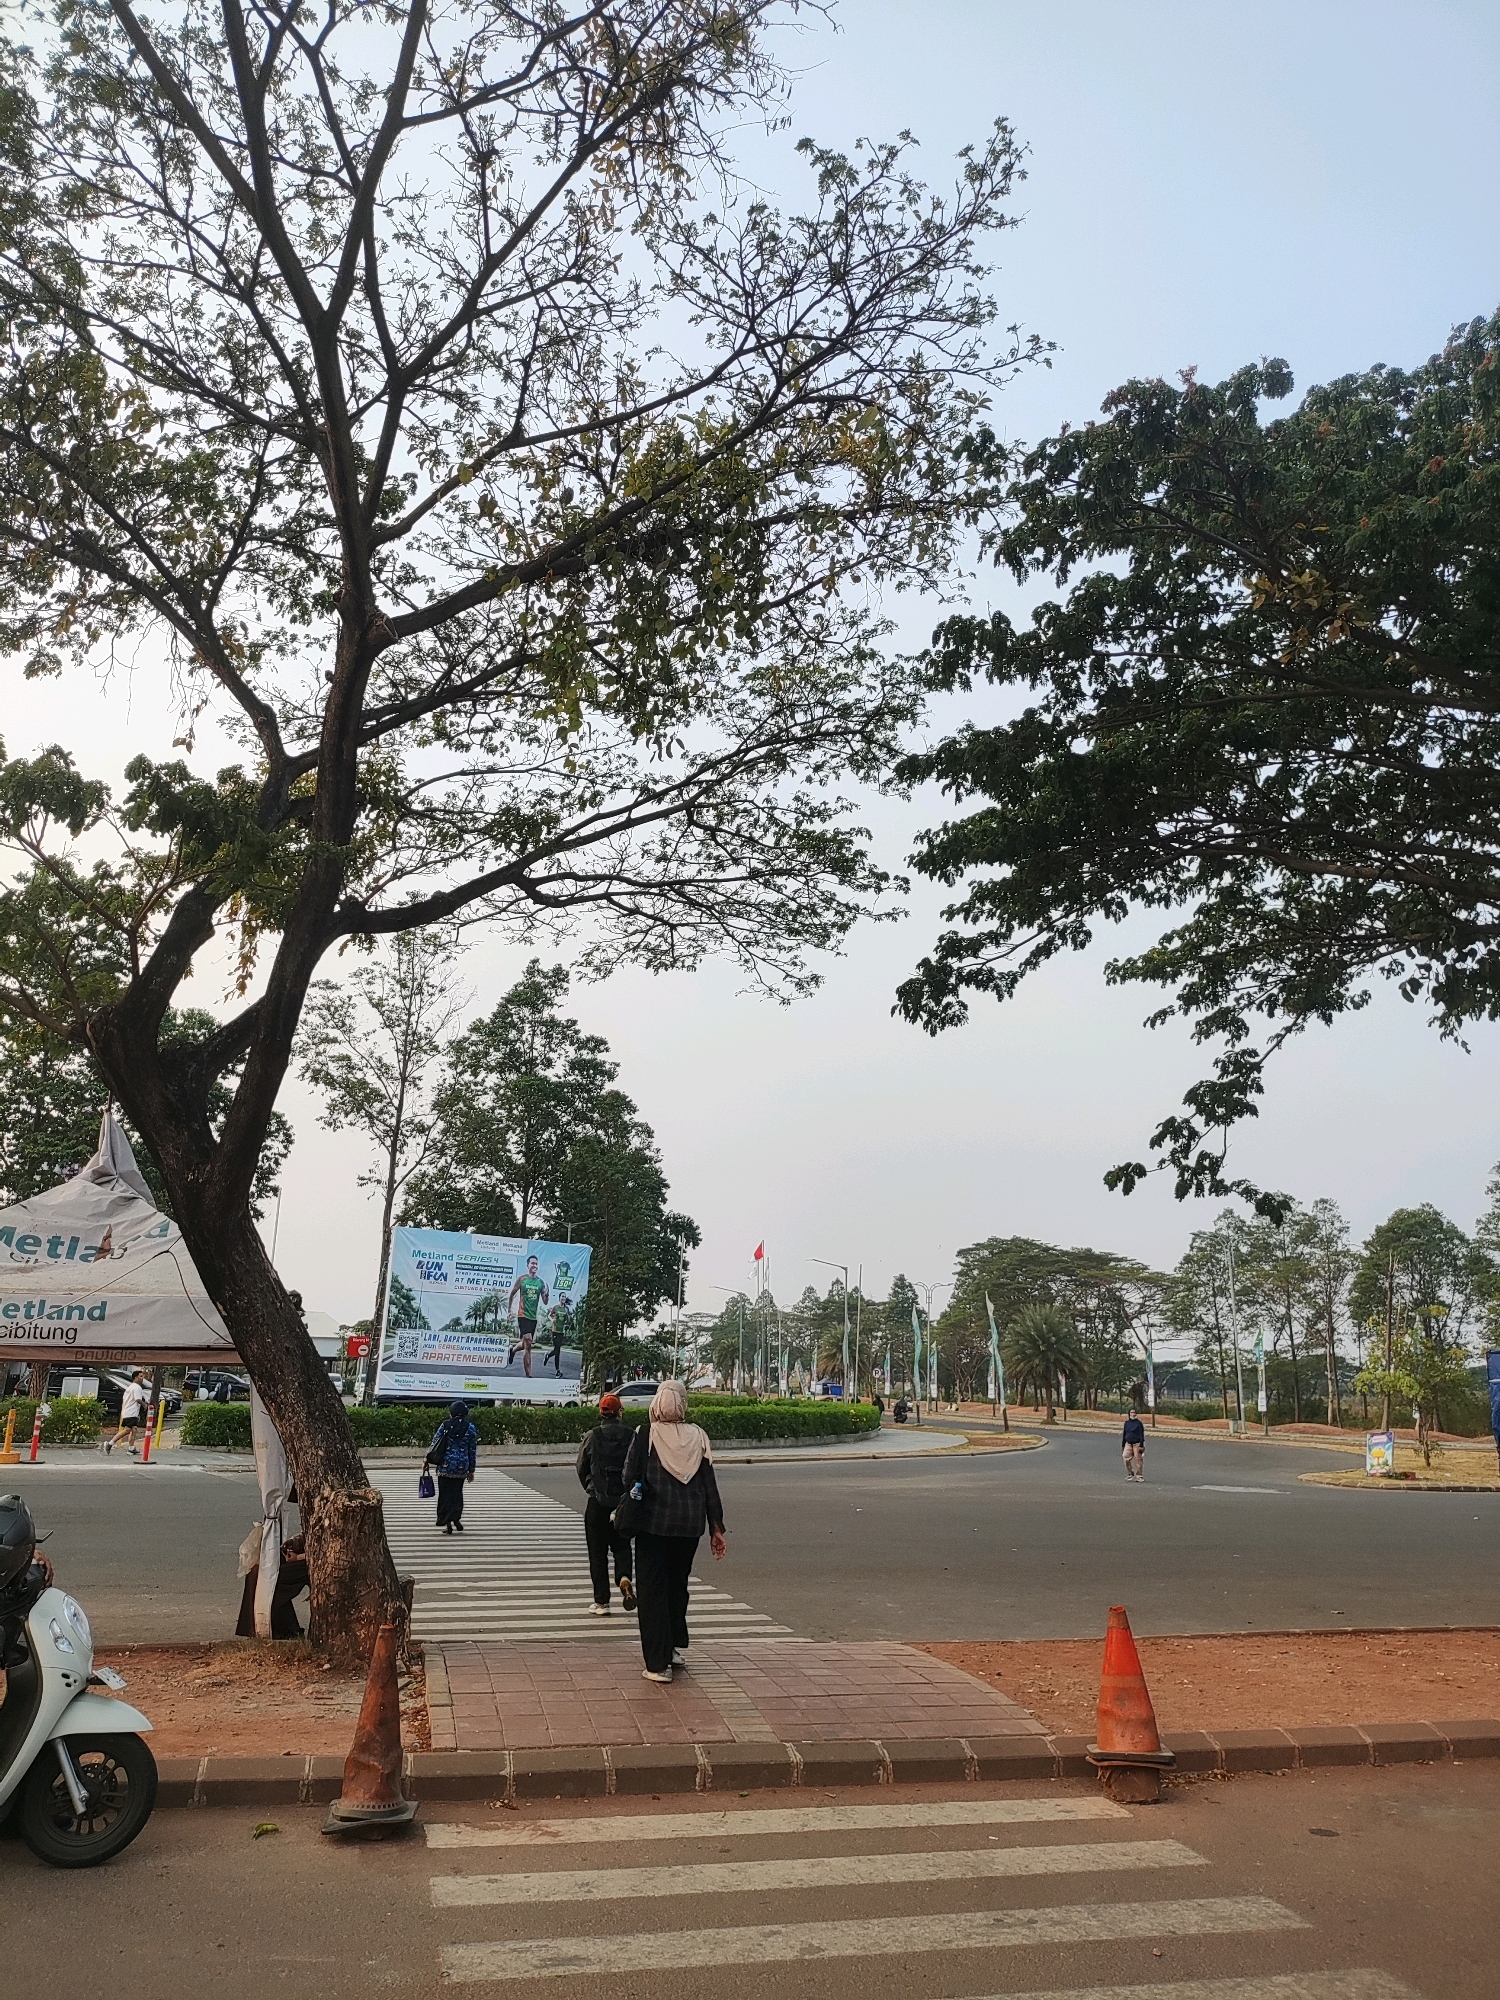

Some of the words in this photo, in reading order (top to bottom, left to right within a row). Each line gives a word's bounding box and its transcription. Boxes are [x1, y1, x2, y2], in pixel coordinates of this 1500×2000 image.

[412, 1250, 454, 1261] Metland
[466, 1278, 512, 1288] METLAND
[0, 1298, 108, 1322] etland
[421, 1352, 504, 1364] APARTEMENNYA
